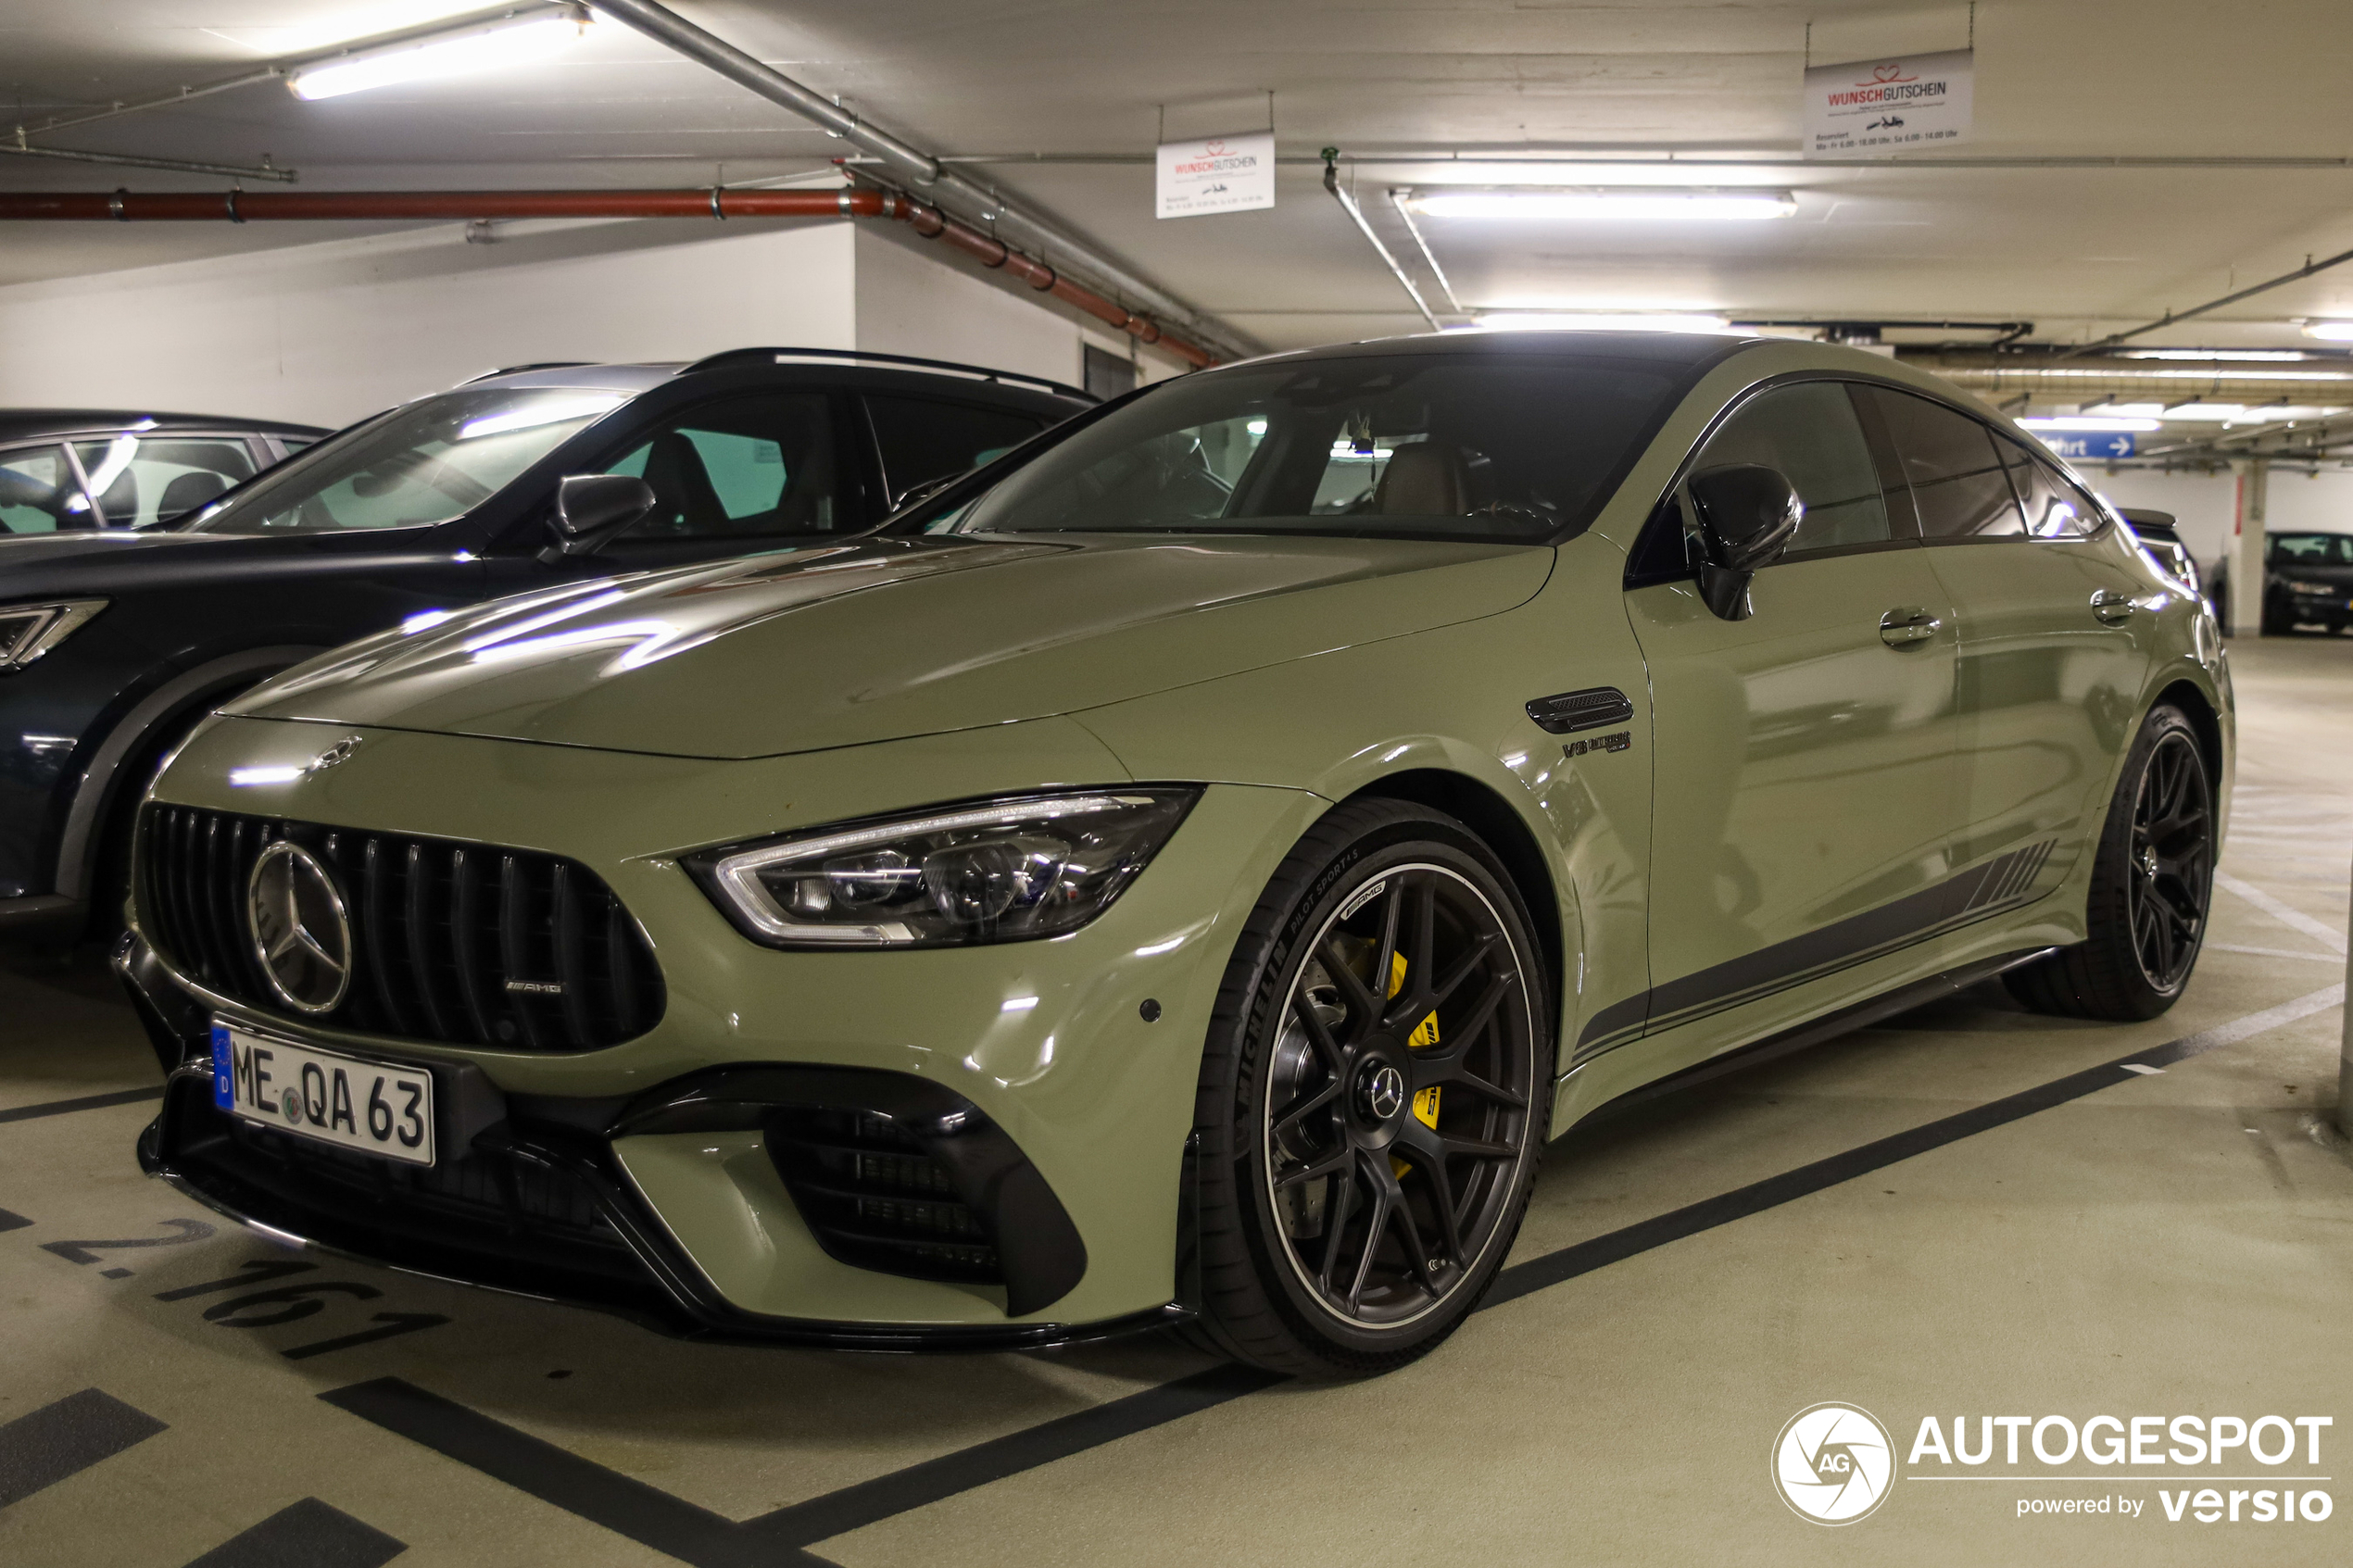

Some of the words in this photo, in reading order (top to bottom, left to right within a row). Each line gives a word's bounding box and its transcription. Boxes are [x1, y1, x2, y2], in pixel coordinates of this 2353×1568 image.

[1827, 81, 1946, 107] WUNSCHGUTSCHEIN
[1816, 132, 1849, 142] Reserviert
[1175, 156, 1257, 175] WUNSCHGUTSCHEIN
[1562, 740, 1588, 759] V8
[1356, 884, 1383, 908] AMG
[1290, 893, 1315, 934] PILOT
[522, 983, 562, 993] AMG
[1237, 939, 1289, 1106] MICHELIN
[221, 1074, 229, 1094] D
[232, 1040, 280, 1114] ME
[302, 1061, 358, 1135] QA
[369, 1075, 425, 1148] 63
